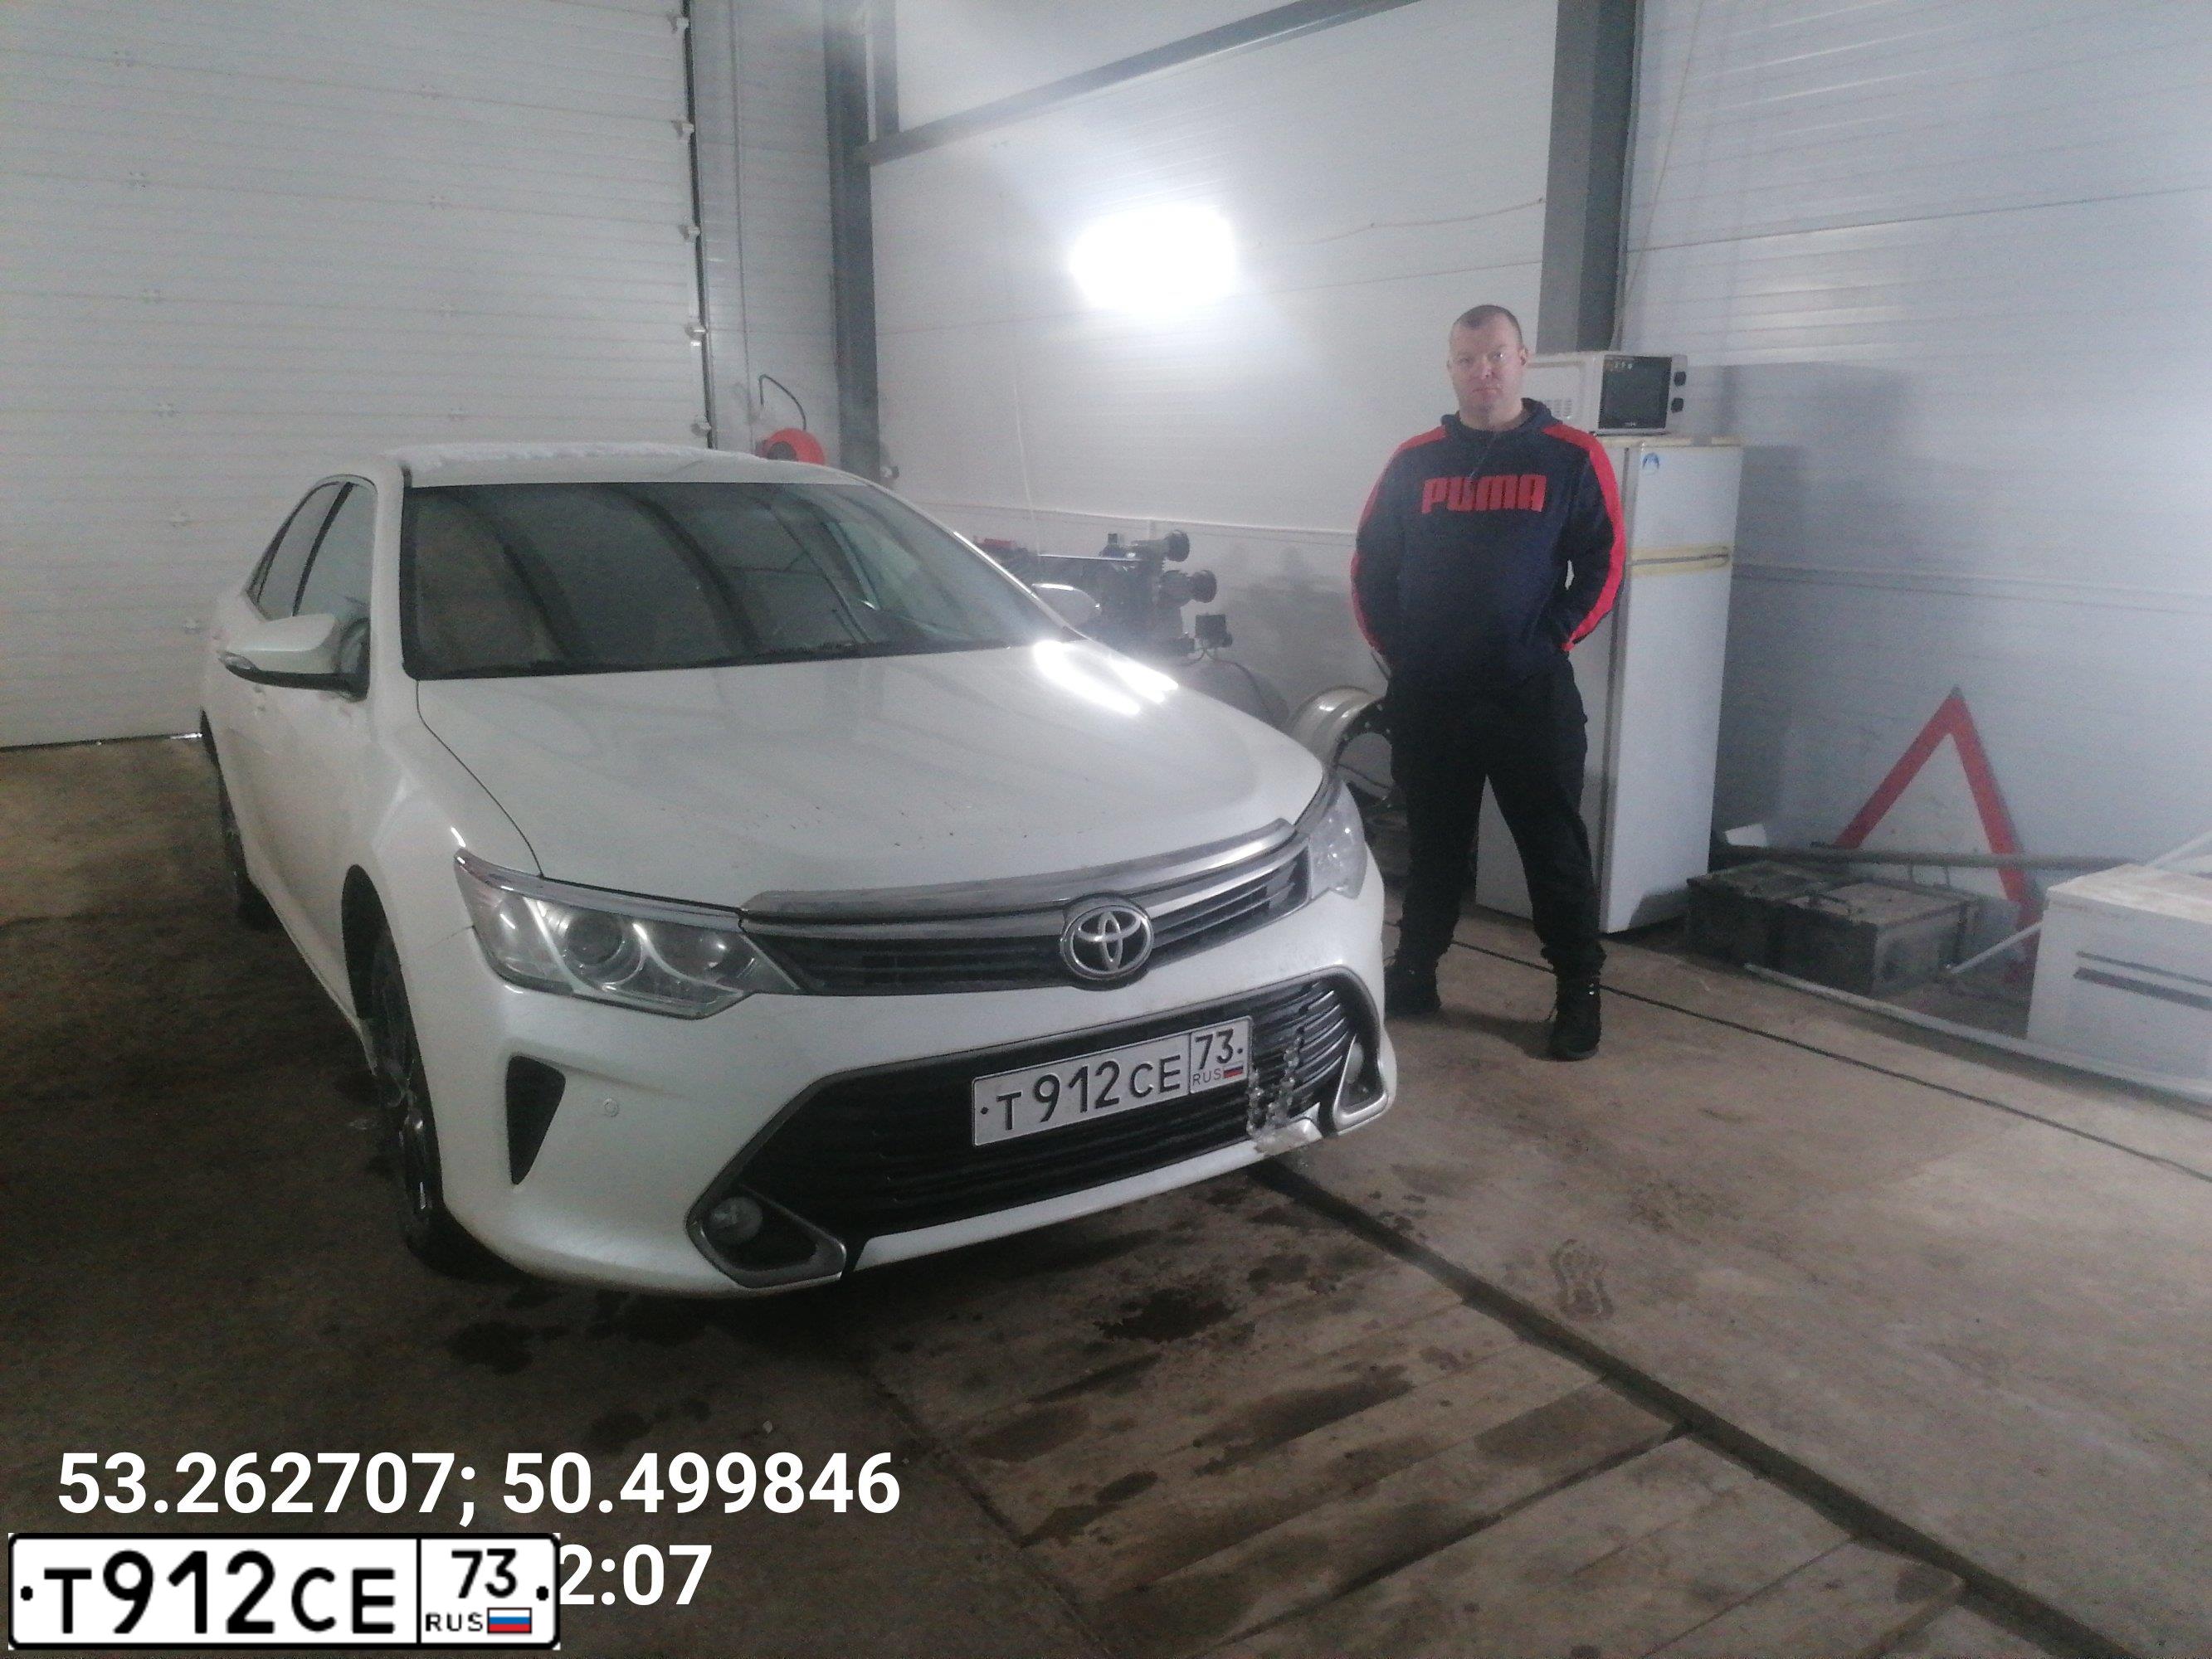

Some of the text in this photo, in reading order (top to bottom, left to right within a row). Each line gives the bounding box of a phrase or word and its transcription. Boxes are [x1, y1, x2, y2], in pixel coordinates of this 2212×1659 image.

[1421, 474, 1547, 513] PUMA
[1195, 1028, 1235, 1070] 73
[1192, 1068, 1221, 1086] RUS
